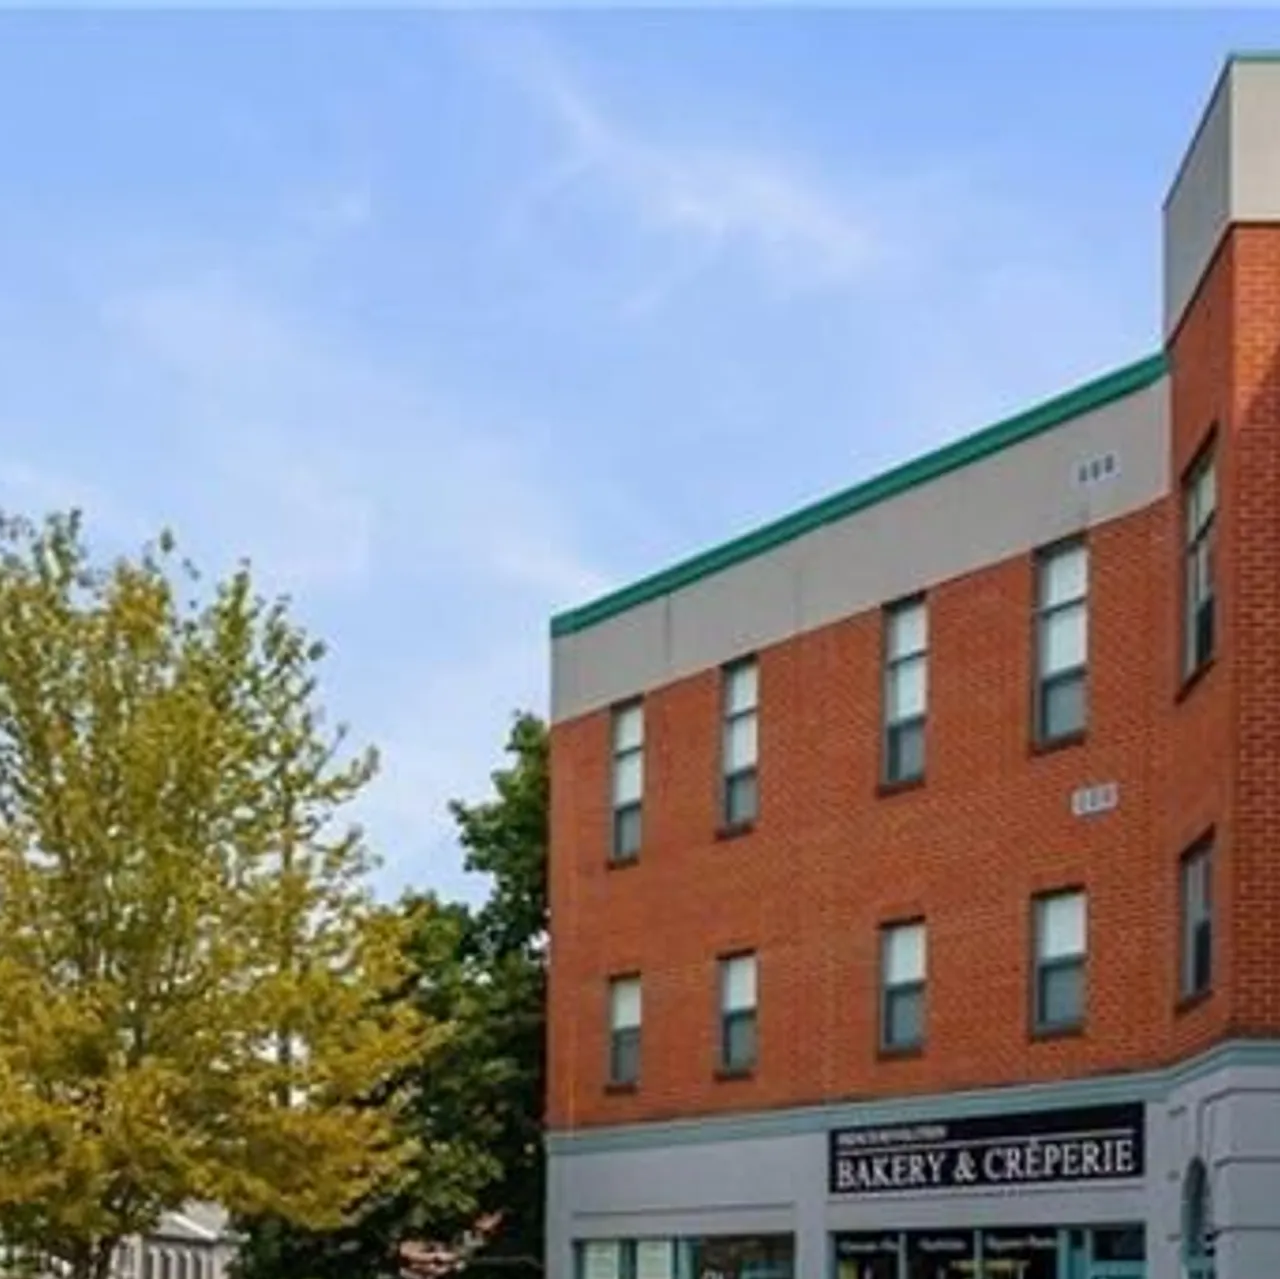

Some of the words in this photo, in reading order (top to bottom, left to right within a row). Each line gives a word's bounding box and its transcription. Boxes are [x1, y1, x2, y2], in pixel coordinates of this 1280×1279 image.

[836, 1152, 946, 1189] BAKERY
[951, 1154, 978, 1183] &
[984, 1137, 1136, 1179] CRÊPERIE
